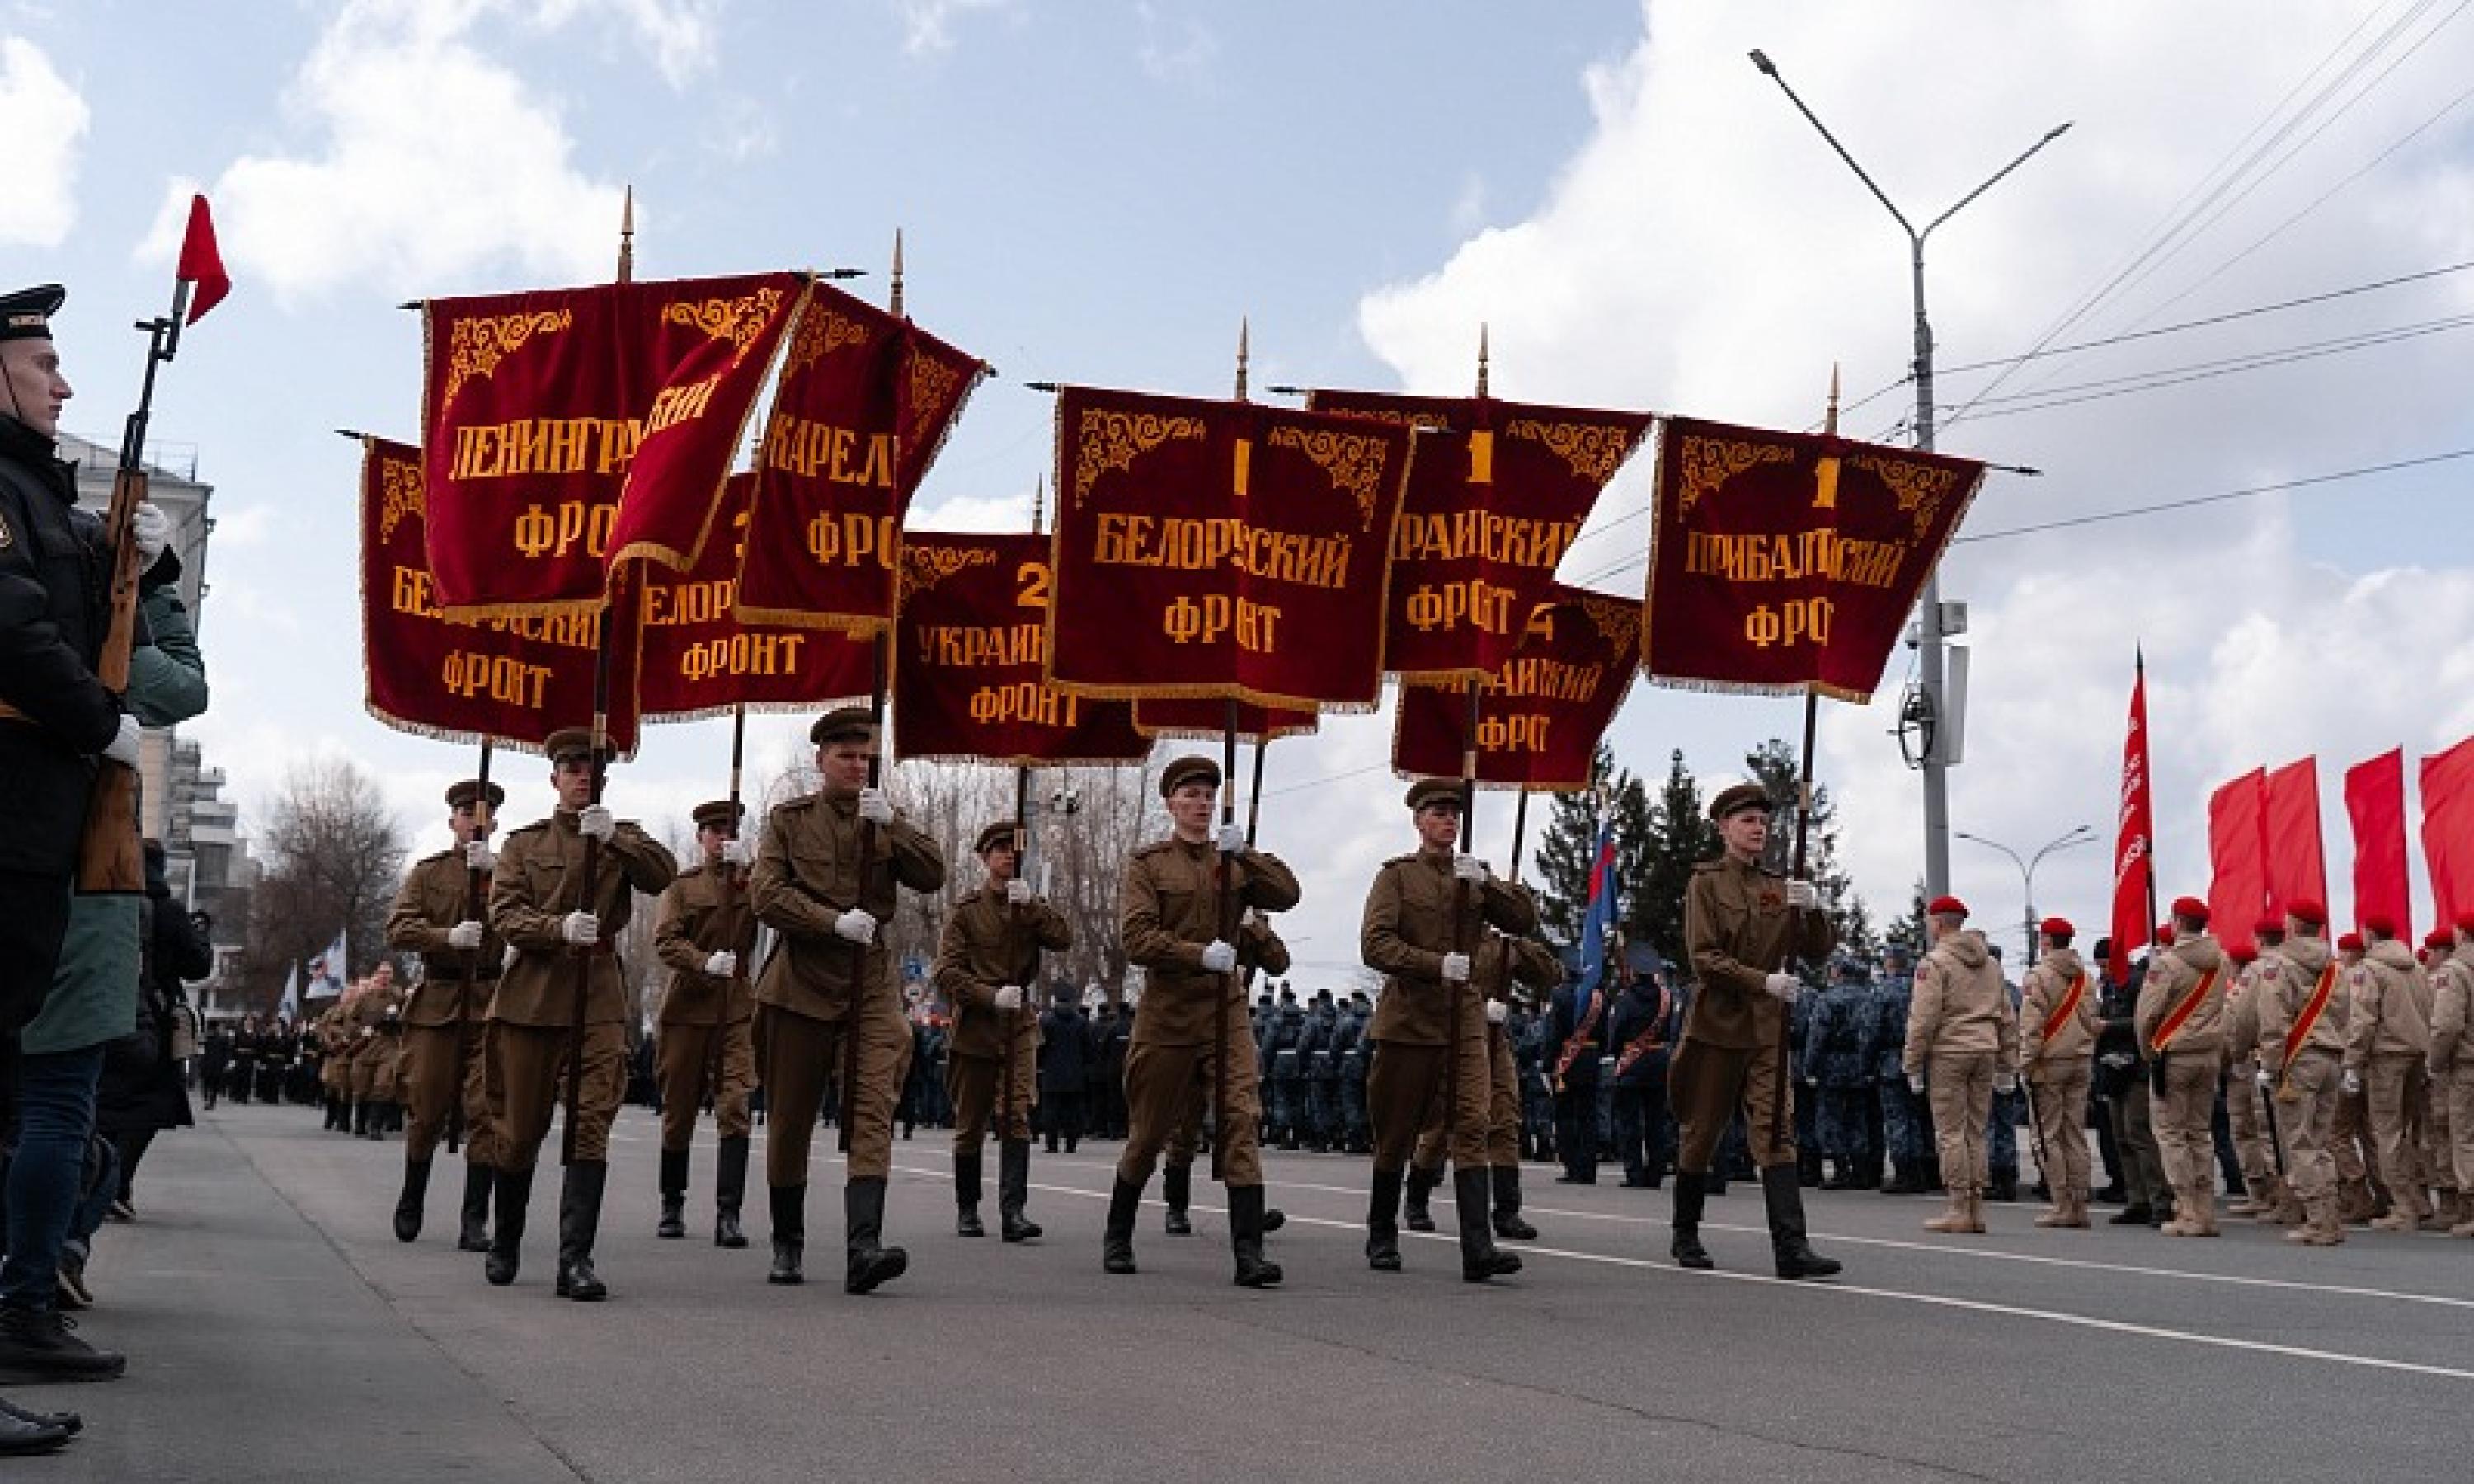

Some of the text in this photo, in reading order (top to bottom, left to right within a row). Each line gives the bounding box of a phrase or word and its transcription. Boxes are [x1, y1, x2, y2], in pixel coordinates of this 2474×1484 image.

[1469, 429, 1494, 483] 1
[1812, 457, 1840, 508] 1
[515, 500, 619, 557] ФРО
[1017, 561, 1050, 607] 2
[681, 633, 806, 683] ФРОНТ
